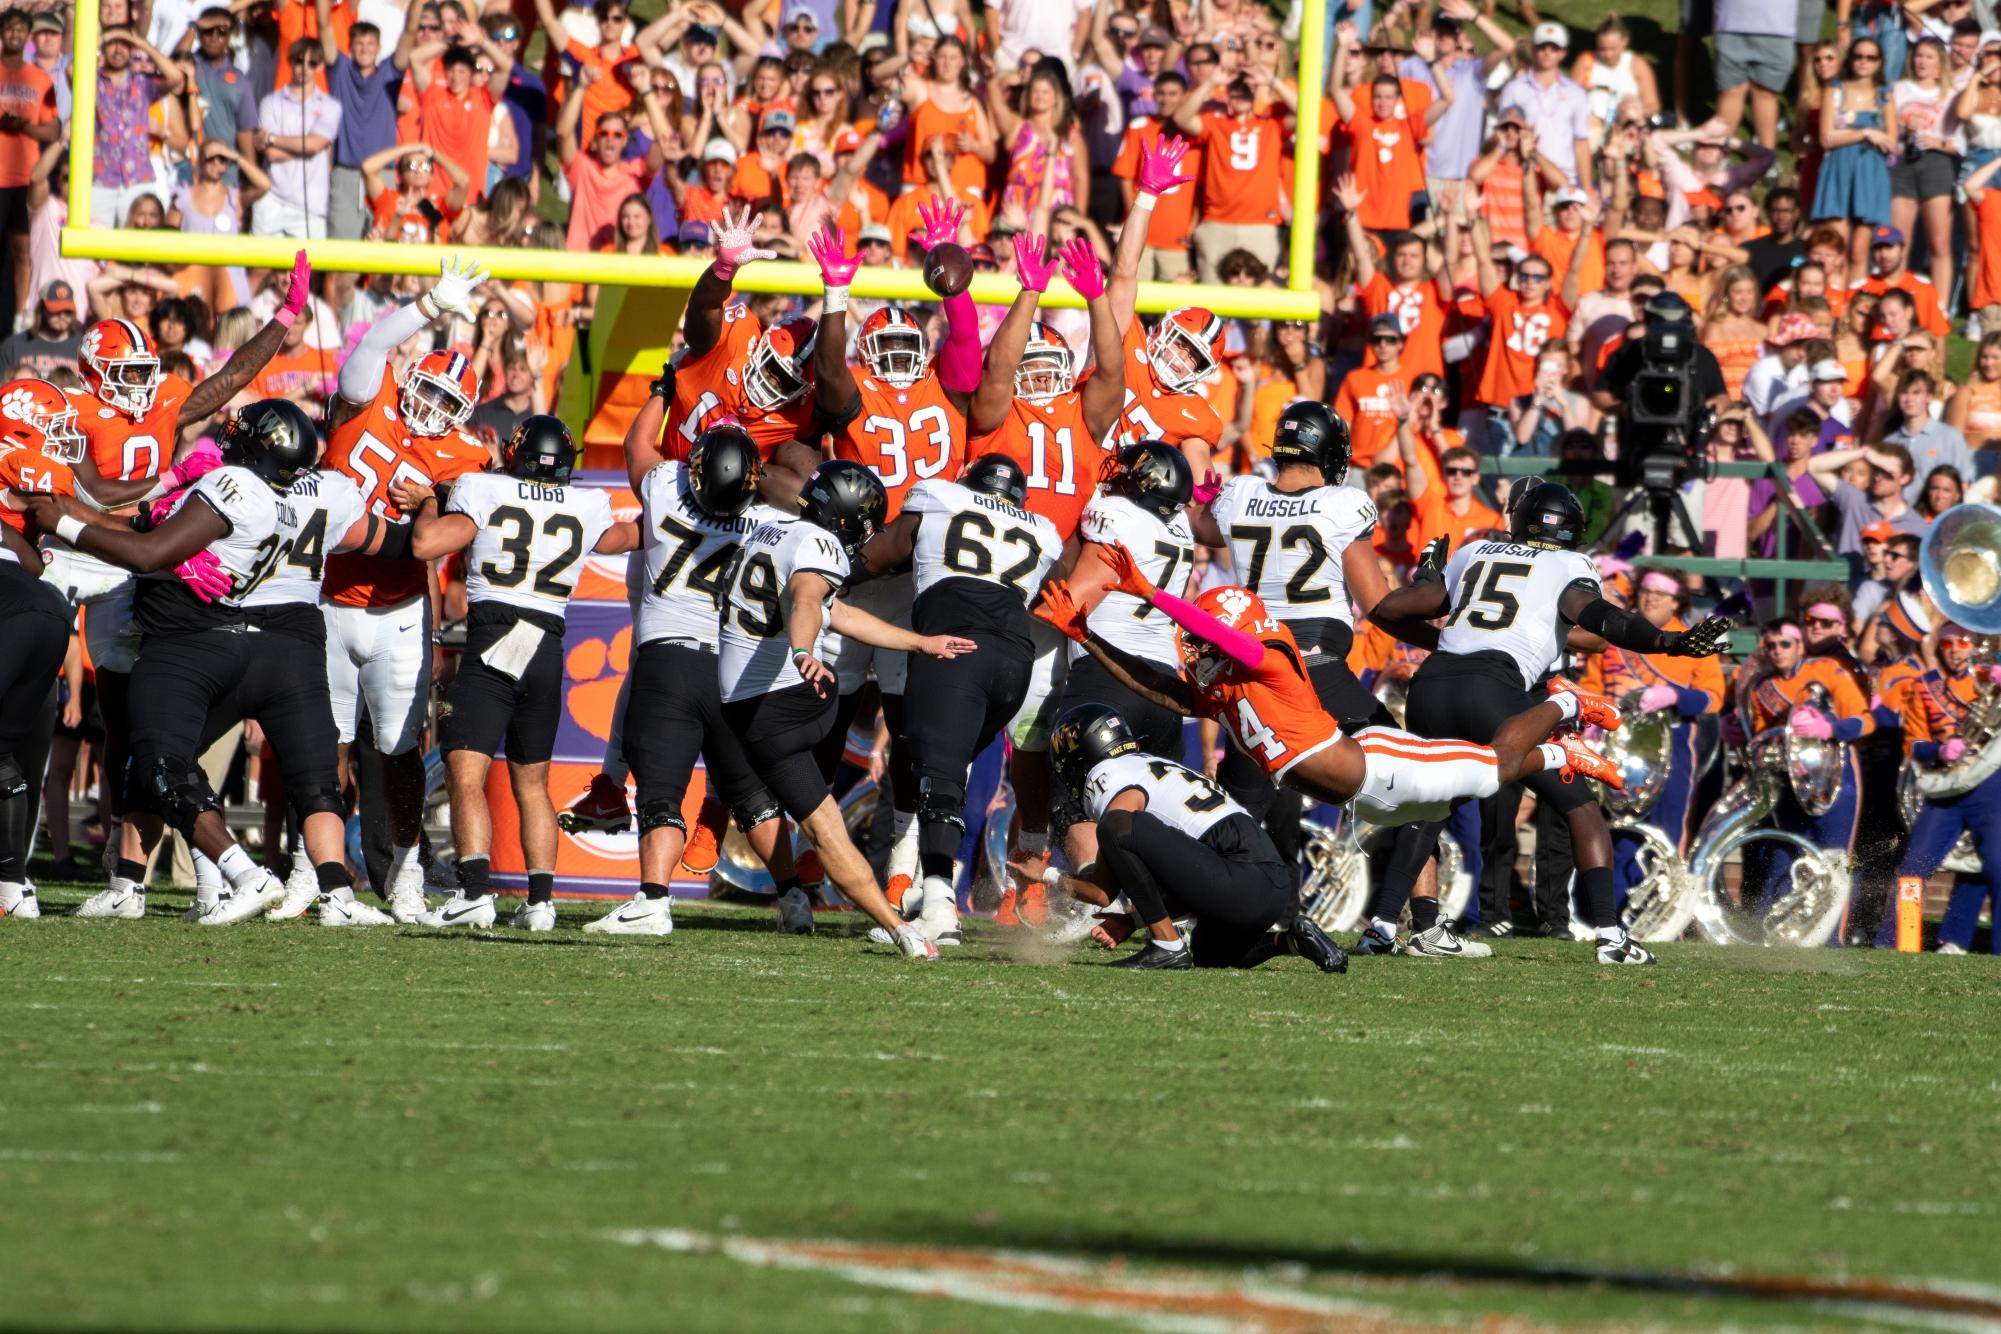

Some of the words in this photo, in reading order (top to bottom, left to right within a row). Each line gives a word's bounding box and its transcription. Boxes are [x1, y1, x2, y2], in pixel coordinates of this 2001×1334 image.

[1230, 131, 1259, 170] 9
[864, 403, 952, 488] 33
[1025, 421, 1077, 496] 11
[19, 466, 53, 492] 54
[215, 473, 243, 506] WF
[518, 482, 565, 504] COBB
[973, 494, 1037, 527] GORDON
[1087, 510, 1115, 535] WF
[1245, 498, 1321, 518] RUSSELL
[481, 504, 584, 599] 32
[815, 537, 843, 566] WF
[943, 509, 1043, 601] 62
[1230, 523, 1332, 605] 72
[1475, 543, 1543, 559] HUDSON
[1444, 560, 1534, 632] 15
[1253, 618, 1280, 635] 14
